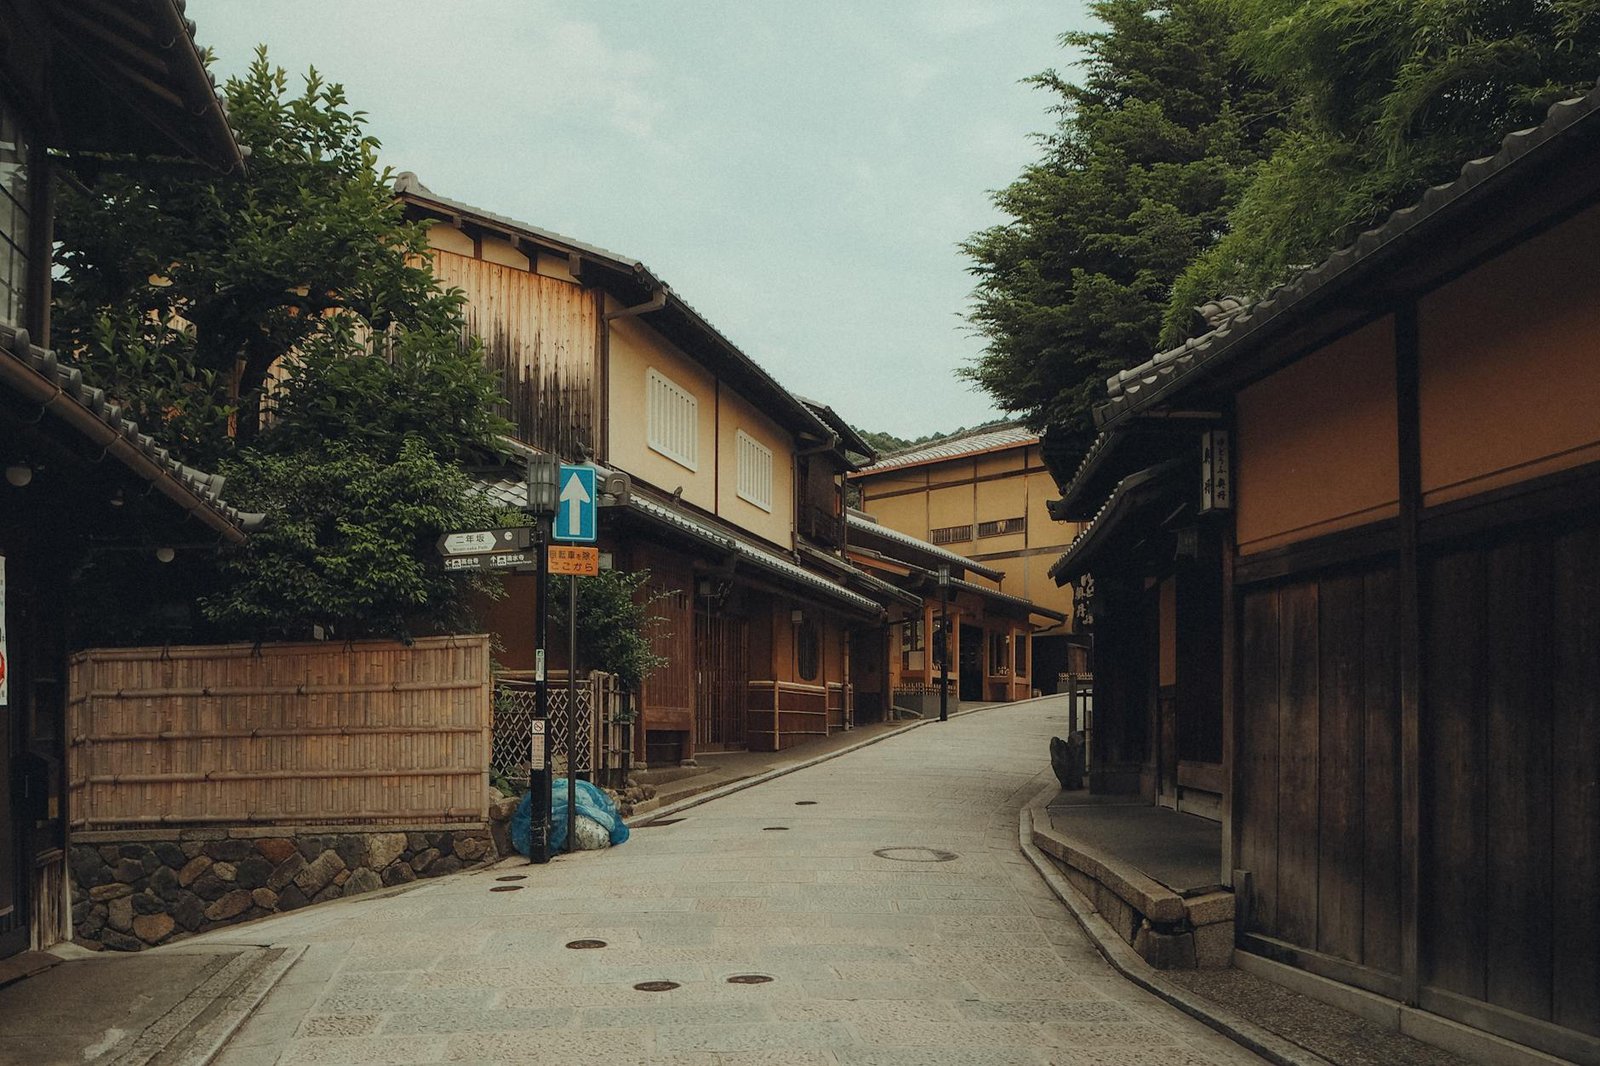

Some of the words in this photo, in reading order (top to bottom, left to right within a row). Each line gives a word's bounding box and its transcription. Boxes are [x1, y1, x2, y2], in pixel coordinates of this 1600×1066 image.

[550, 550, 596, 561] 自転車を除く
[551, 561, 593, 572] ここから
